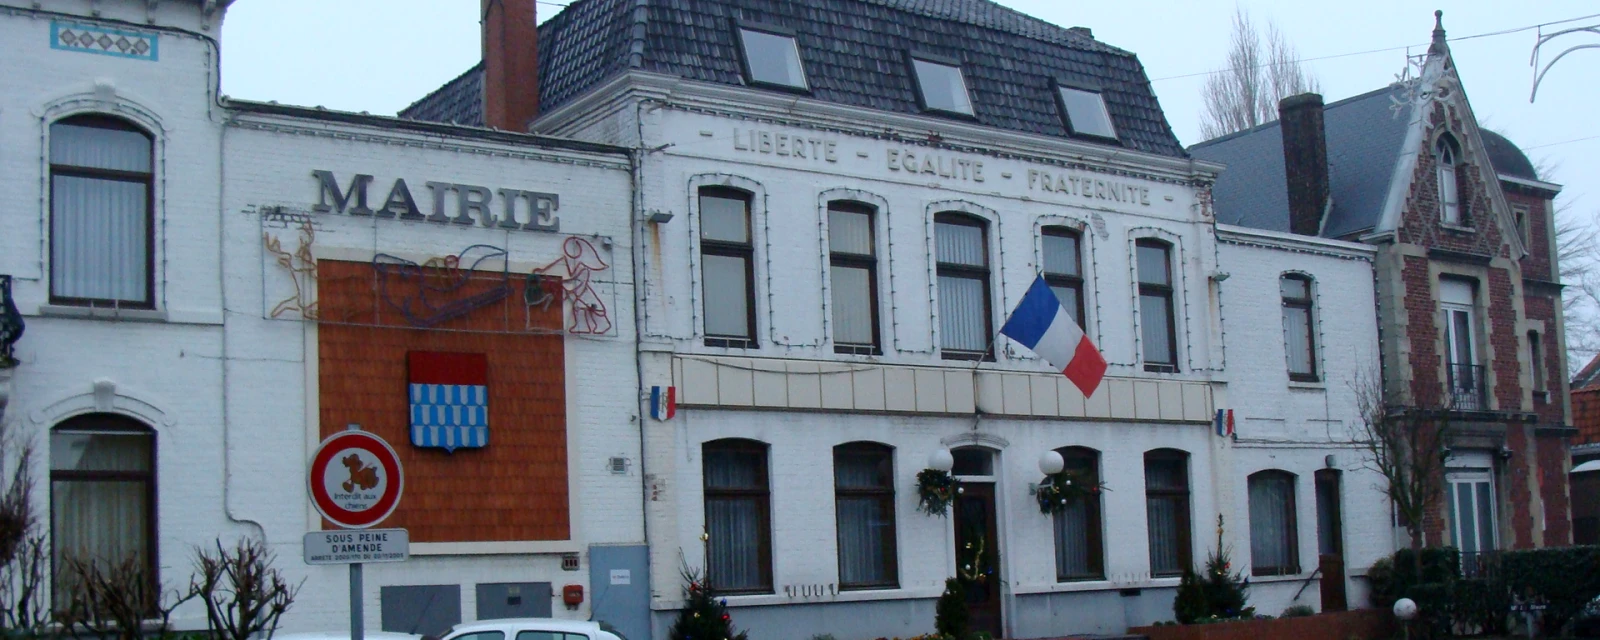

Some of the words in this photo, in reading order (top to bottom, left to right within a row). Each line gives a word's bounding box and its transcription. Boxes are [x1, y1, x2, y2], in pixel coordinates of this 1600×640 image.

[734, 128, 837, 163] LIBERTE
[886, 149, 985, 183] EGALITE
[1027, 168, 1151, 206] FRATERNITE
[312, 169, 561, 232] MAIRIE
[344, 502, 368, 510] chiens
[326, 534, 353, 543] SOUS
[359, 533, 388, 542] PEINE
[332, 543, 383, 553] D'AMENDE
